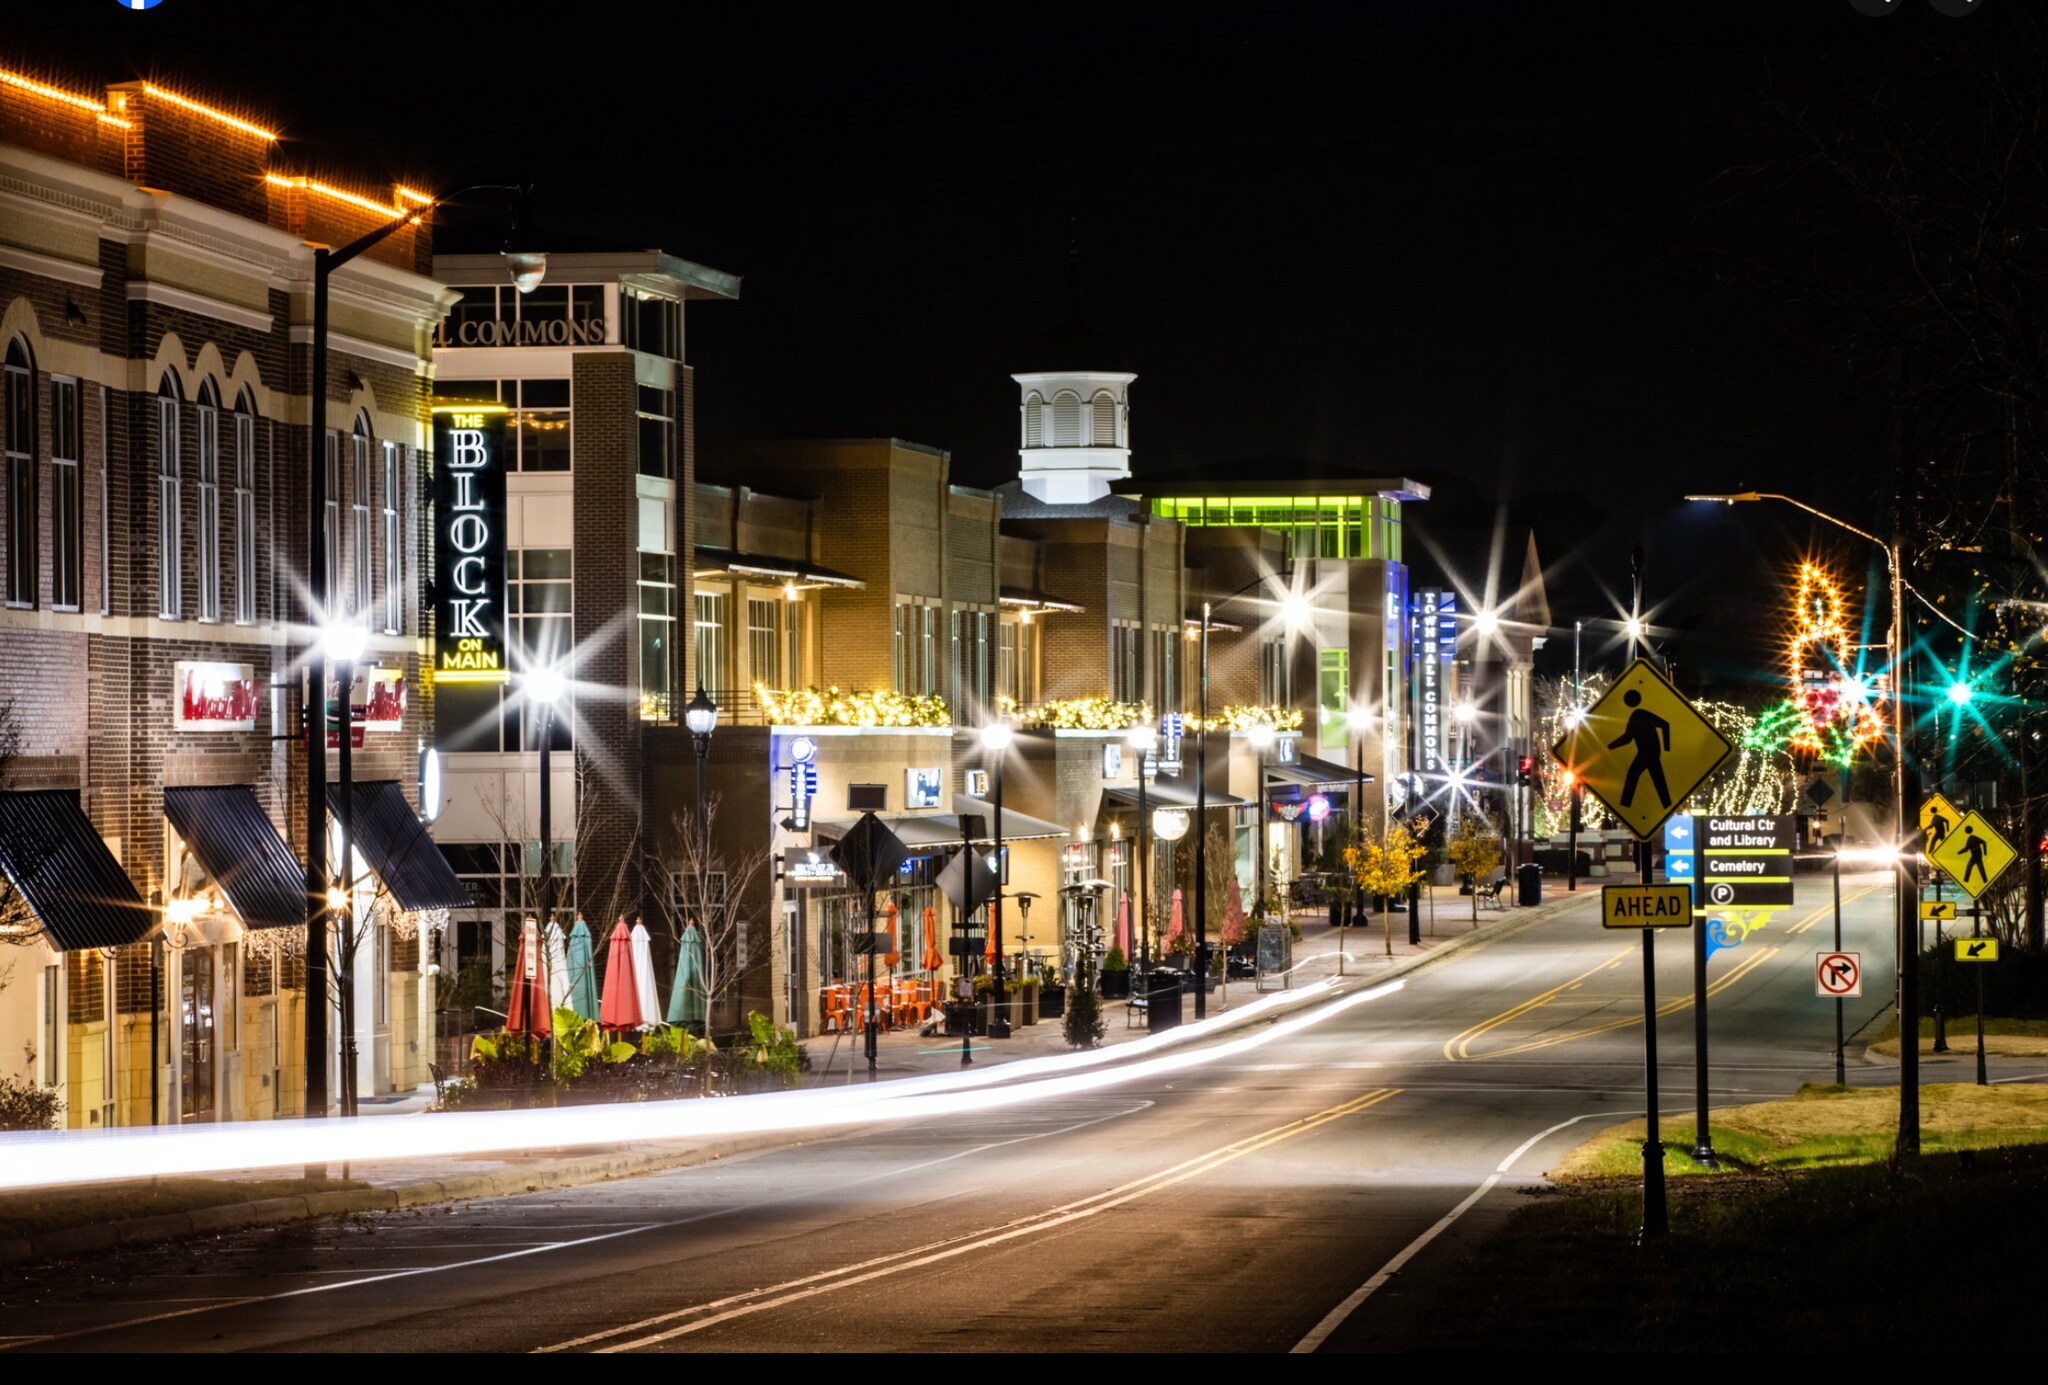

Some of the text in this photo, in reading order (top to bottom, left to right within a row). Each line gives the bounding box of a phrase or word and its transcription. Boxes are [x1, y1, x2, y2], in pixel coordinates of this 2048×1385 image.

[432, 319, 604, 345] L COMMONS
[452, 414, 484, 428] THE
[448, 429, 490, 637] BLOCK
[458, 639, 482, 651] ON
[443, 652, 498, 669] MAIN
[1424, 593, 1437, 770] TOWN HALL COMMONS
[1710, 819, 1775, 831] Cultural Ctr
[1710, 834, 1776, 848] and Library
[1710, 860, 1766, 874] Cemetery
[1717, 887, 1728, 899] P
[1614, 896, 1681, 917] AHEAD
